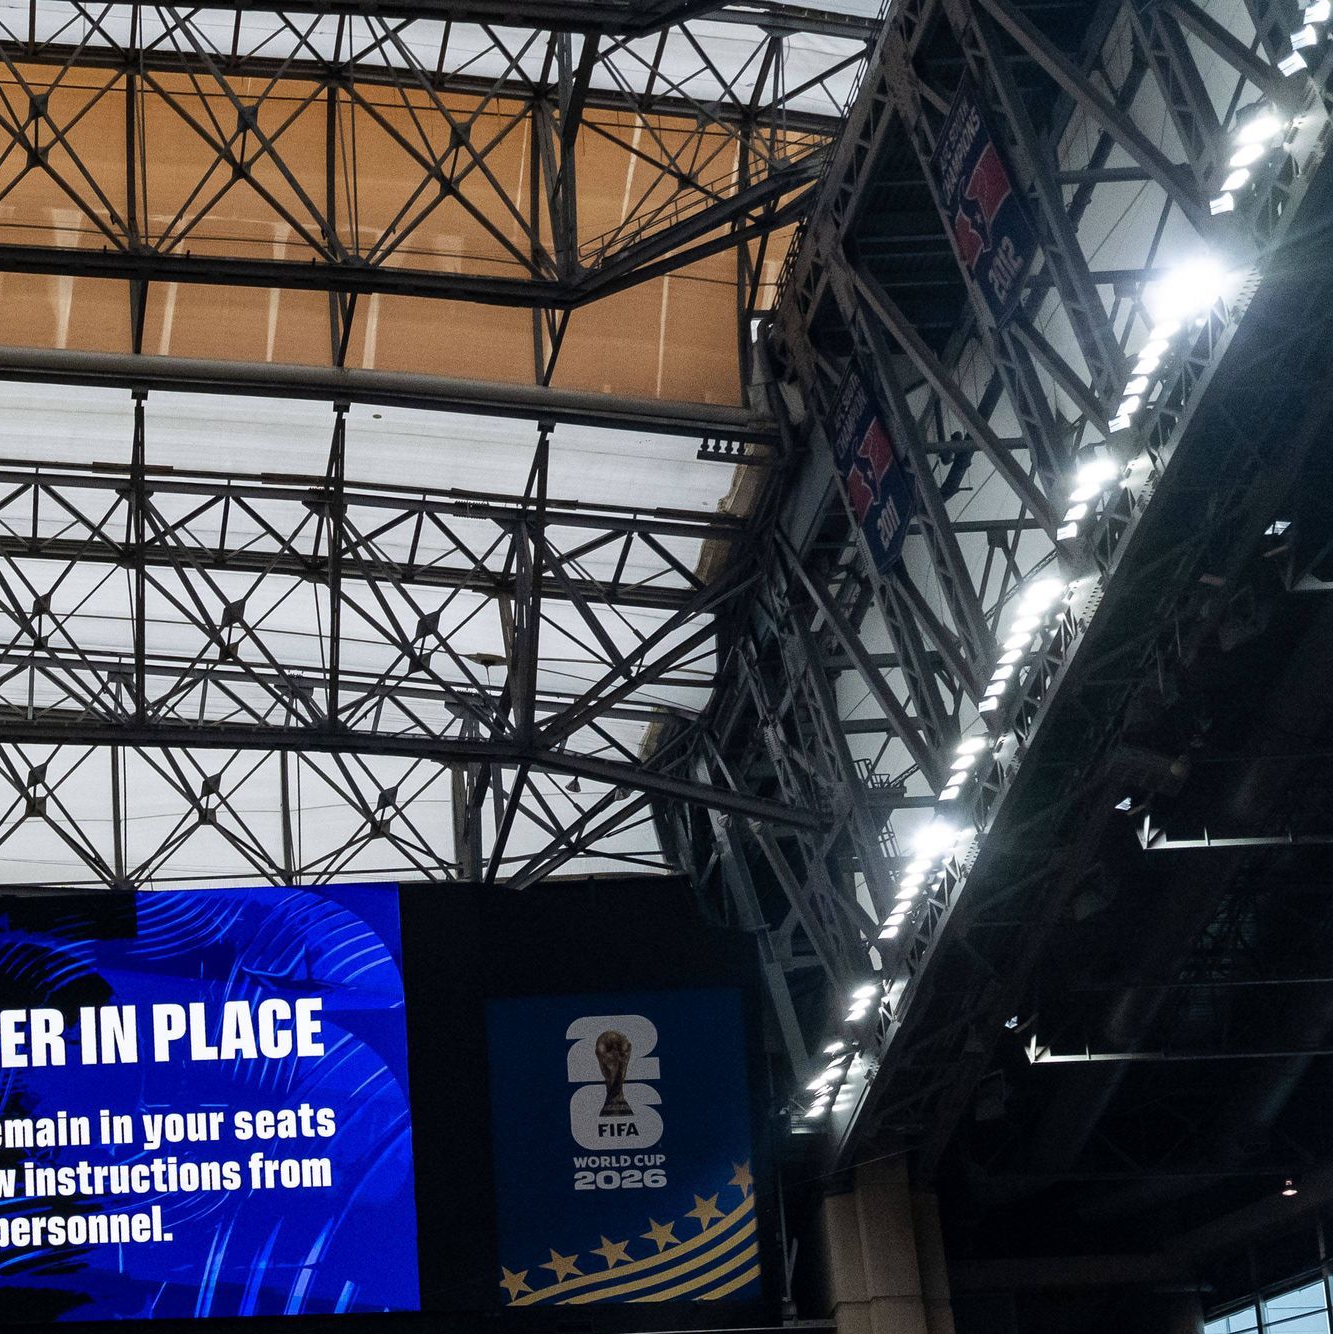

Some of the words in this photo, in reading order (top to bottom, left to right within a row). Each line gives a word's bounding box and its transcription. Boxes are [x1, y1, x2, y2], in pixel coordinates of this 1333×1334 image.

[988, 236, 1023, 304] 2012
[80, 1005, 137, 1064] IN
[153, 998, 324, 1061] PLACE
[100, 1110, 132, 1144] in
[143, 1112, 223, 1149] your
[235, 1104, 335, 1140] seats
[598, 1123, 639, 1137] FIFA
[25, 1157, 241, 1196] instructions
[249, 1153, 331, 1189] from
[573, 1156, 631, 1168] WORLD
[633, 1154, 666, 1166] CUP
[573, 1168, 668, 1191] 2026
